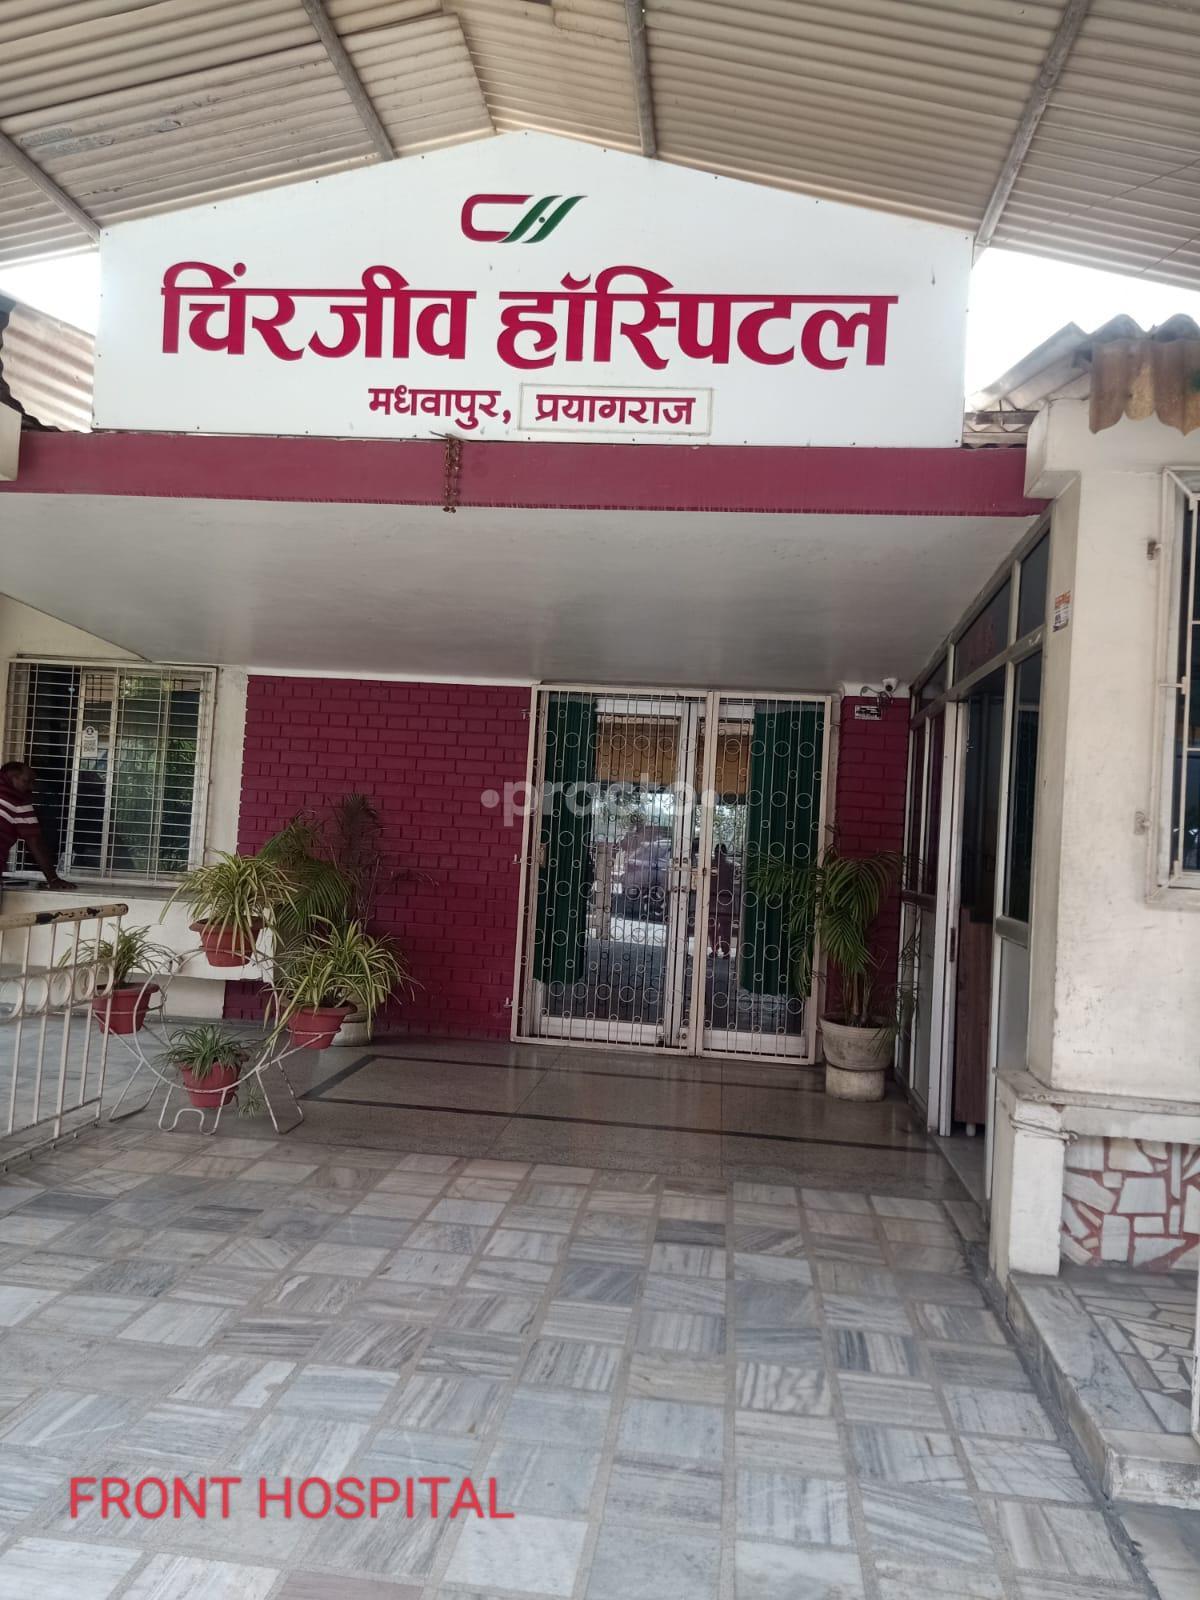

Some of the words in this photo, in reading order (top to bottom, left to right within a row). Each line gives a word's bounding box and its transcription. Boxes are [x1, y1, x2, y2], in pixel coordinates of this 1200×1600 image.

[497, 265, 898, 370] हॉस्पिटल
[368, 385, 511, 429] मधवापुर,
[535, 394, 696, 424] प्रयागराज
